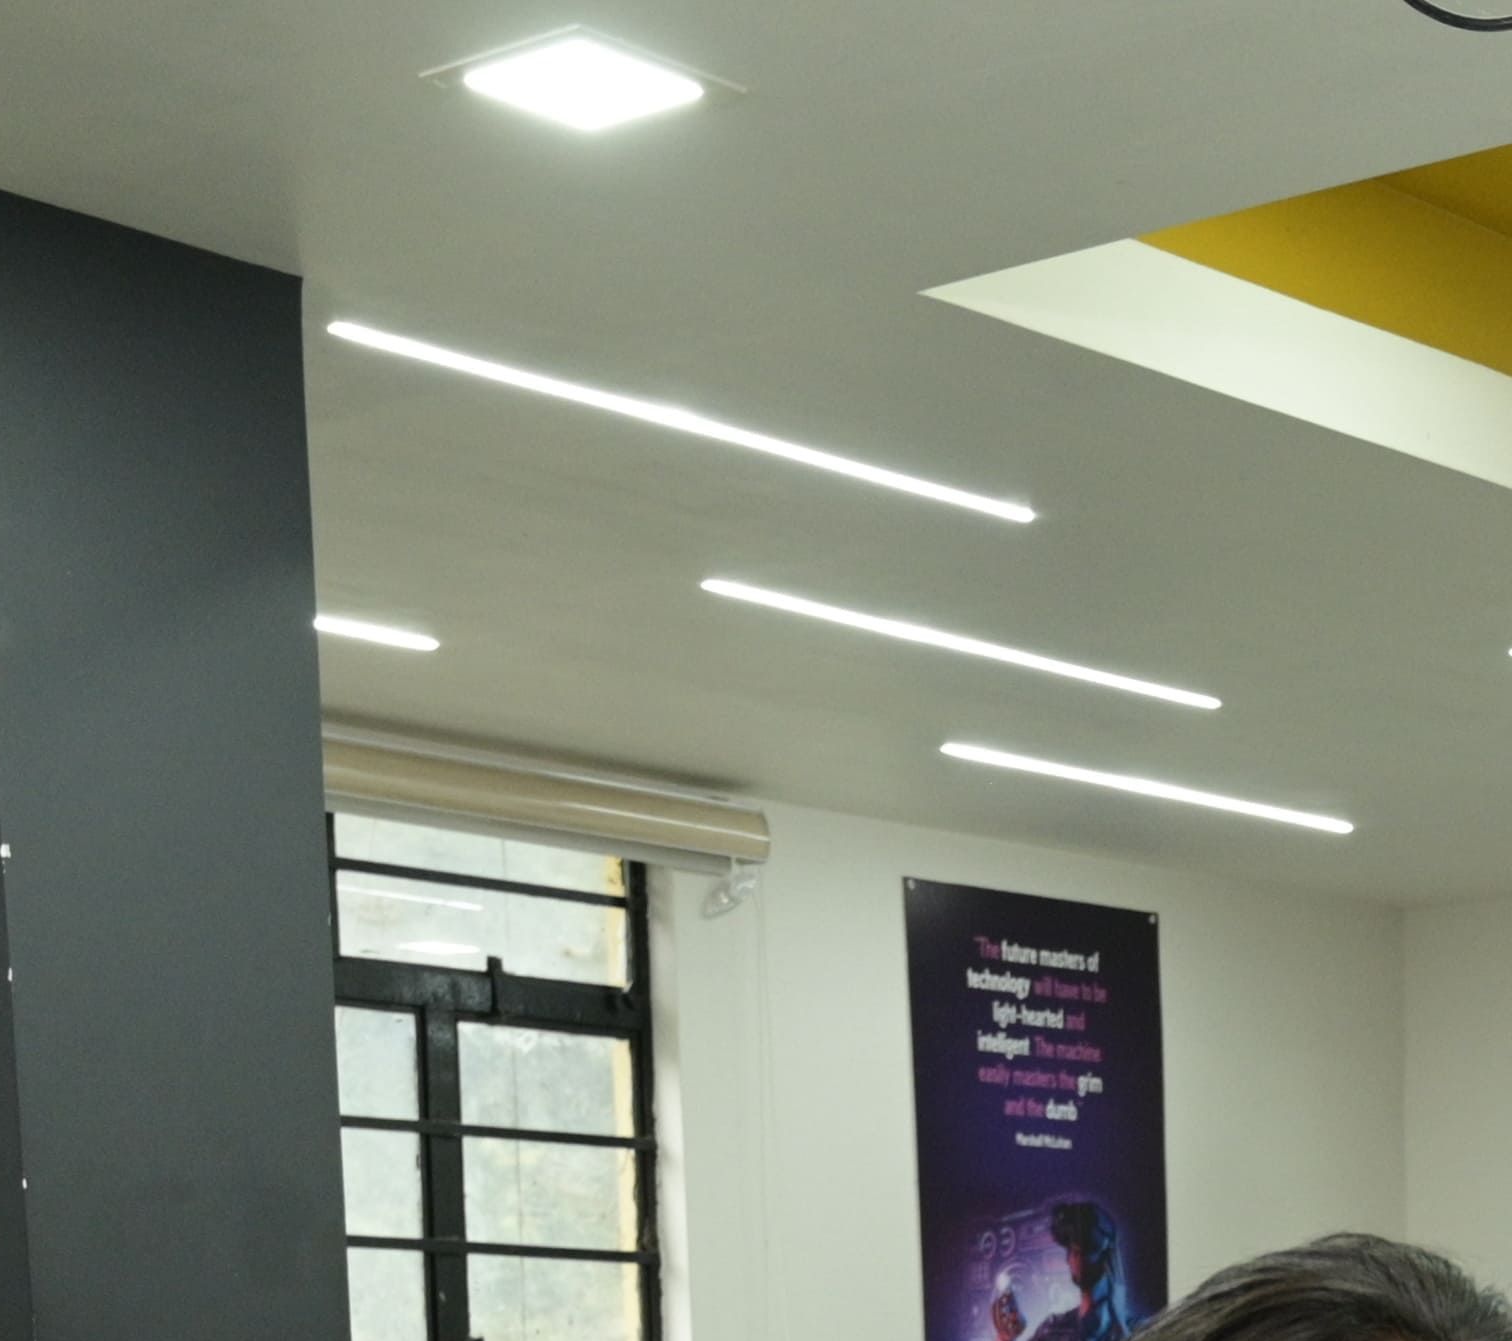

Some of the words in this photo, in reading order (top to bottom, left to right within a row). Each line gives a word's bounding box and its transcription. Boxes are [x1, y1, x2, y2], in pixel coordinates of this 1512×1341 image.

[1000, 939, 1038, 965] future
[1038, 949, 1086, 971] masters
[1087, 951, 1100, 973] of
[966, 966, 1031, 1000] technology
[992, 1000, 1064, 1030] light-hearted
[1077, 1072, 1104, 1097] grim
